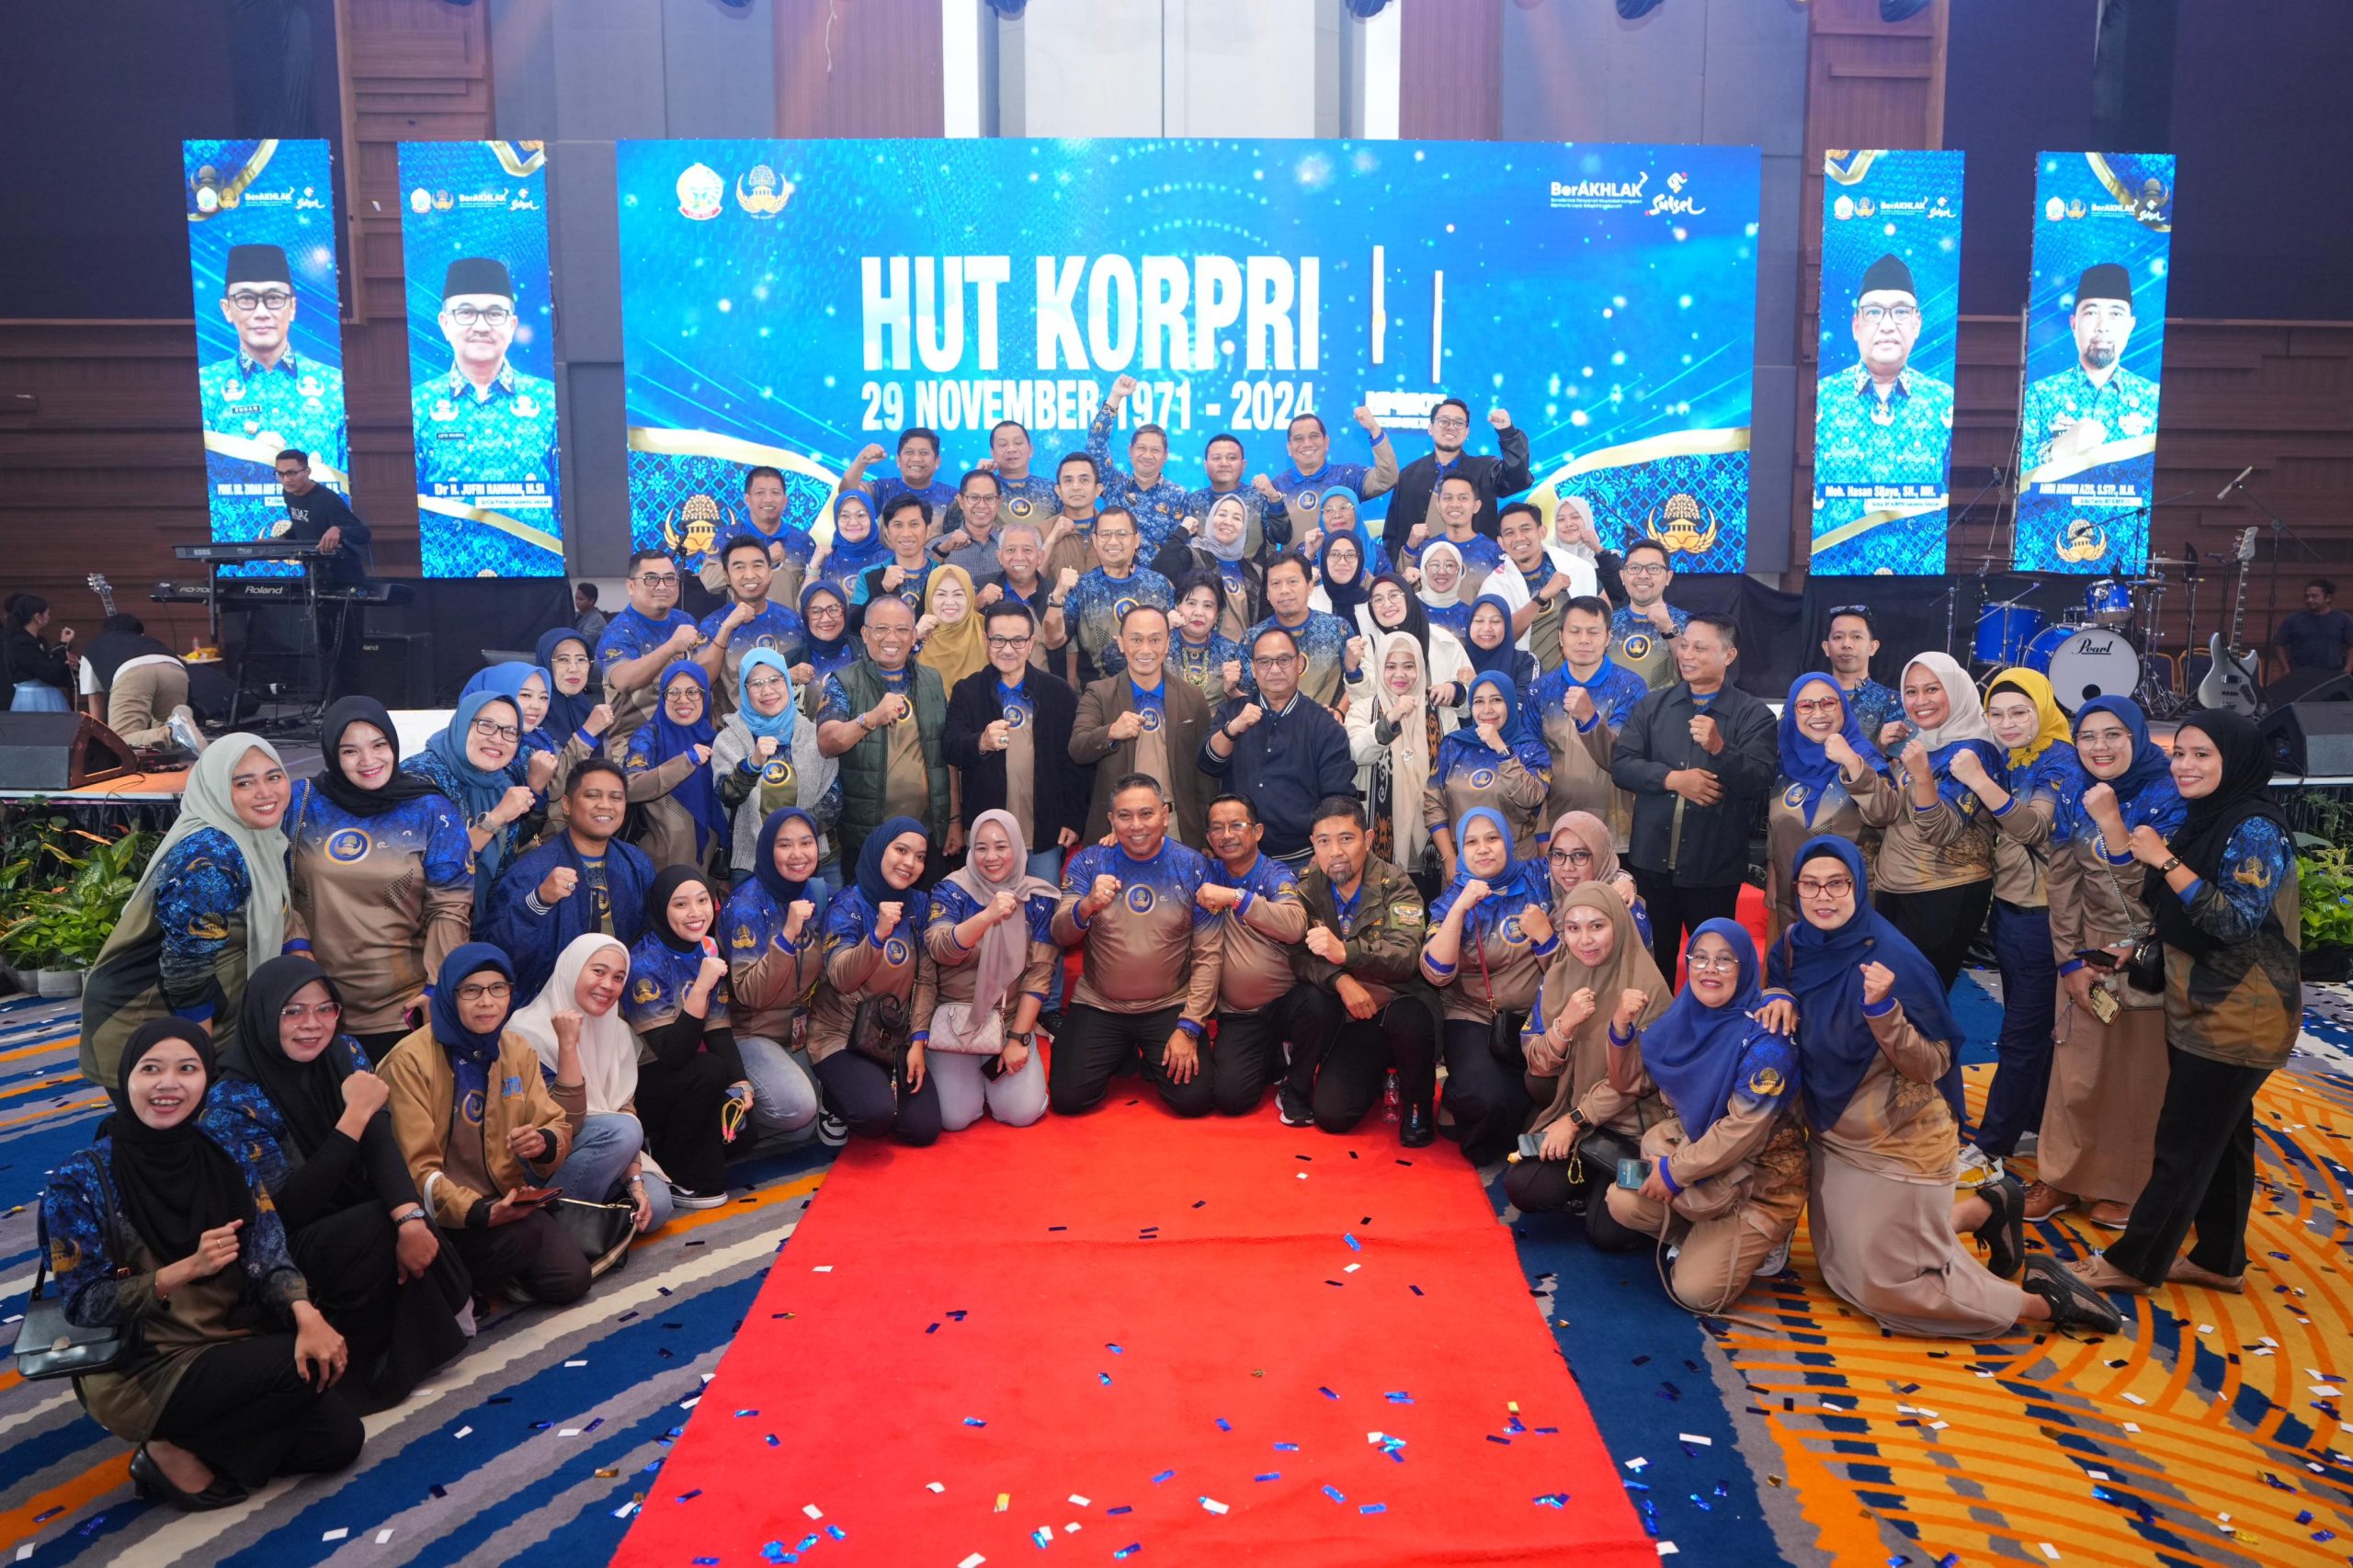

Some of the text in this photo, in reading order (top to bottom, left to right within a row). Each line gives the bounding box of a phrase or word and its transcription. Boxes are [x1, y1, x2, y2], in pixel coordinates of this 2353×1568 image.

[1551, 177, 1645, 197] BerAKHLAK
[861, 254, 1319, 372] HUT KORPRI
[861, 381, 904, 430] 29
[915, 380, 1100, 429] NOVEMBER
[1118, 381, 1190, 429] 1971
[1206, 403, 1221, 415] -
[1232, 381, 1314, 430] 2024
[434, 483, 449, 495] Dr
[460, 483, 485, 495] JUFRI
[486, 483, 525, 496] RAHMAN,
[1825, 485, 1846, 497] Moh.
[1847, 485, 1873, 497] Hasan
[244, 585, 283, 595] Roland
[2072, 637, 2113, 654] Pearl
